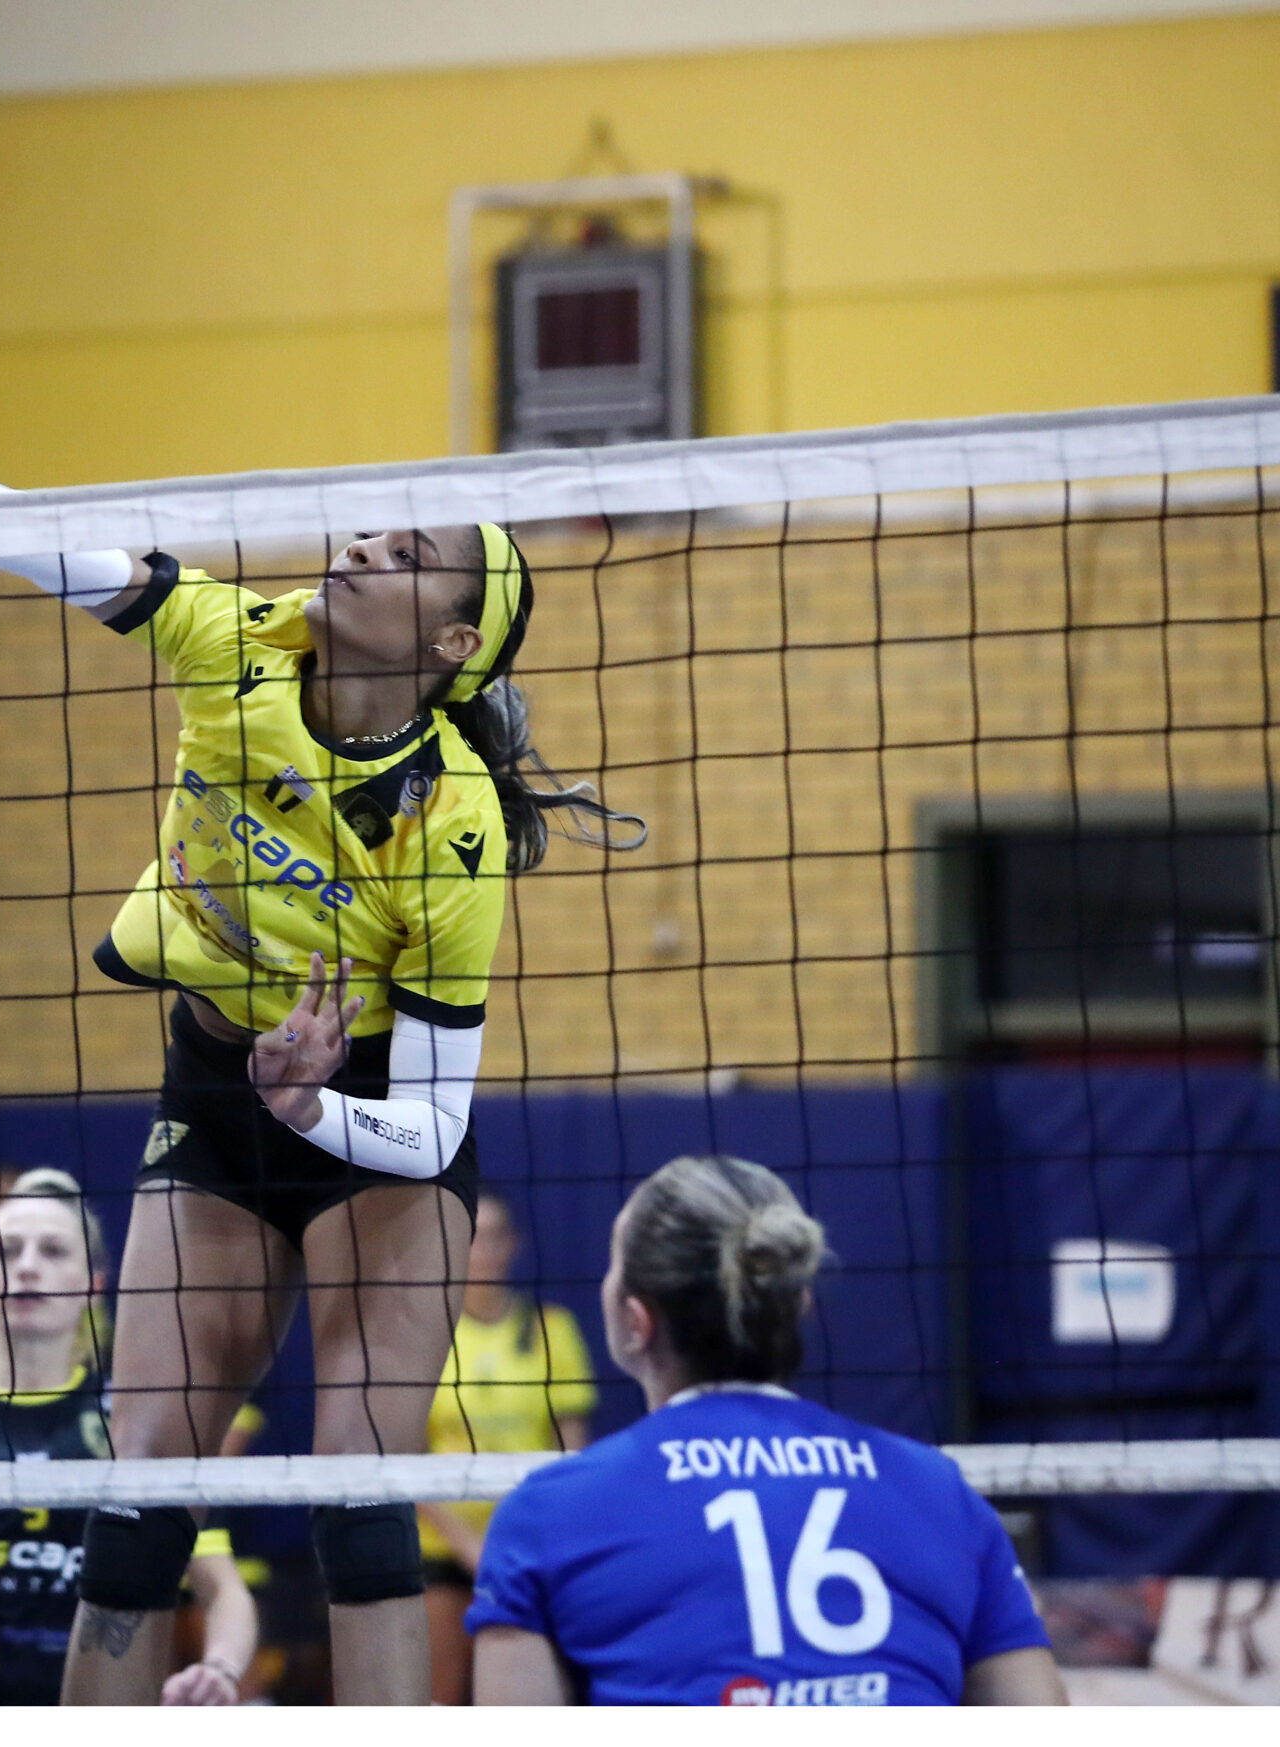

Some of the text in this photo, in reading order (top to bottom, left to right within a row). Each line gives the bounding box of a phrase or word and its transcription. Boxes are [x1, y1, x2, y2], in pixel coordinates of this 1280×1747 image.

[353, 1106, 421, 1150] ninesquared
[660, 1436, 878, 1482] ΣΟΥΛΙΩΤΗ
[704, 1488, 893, 1658] 16
